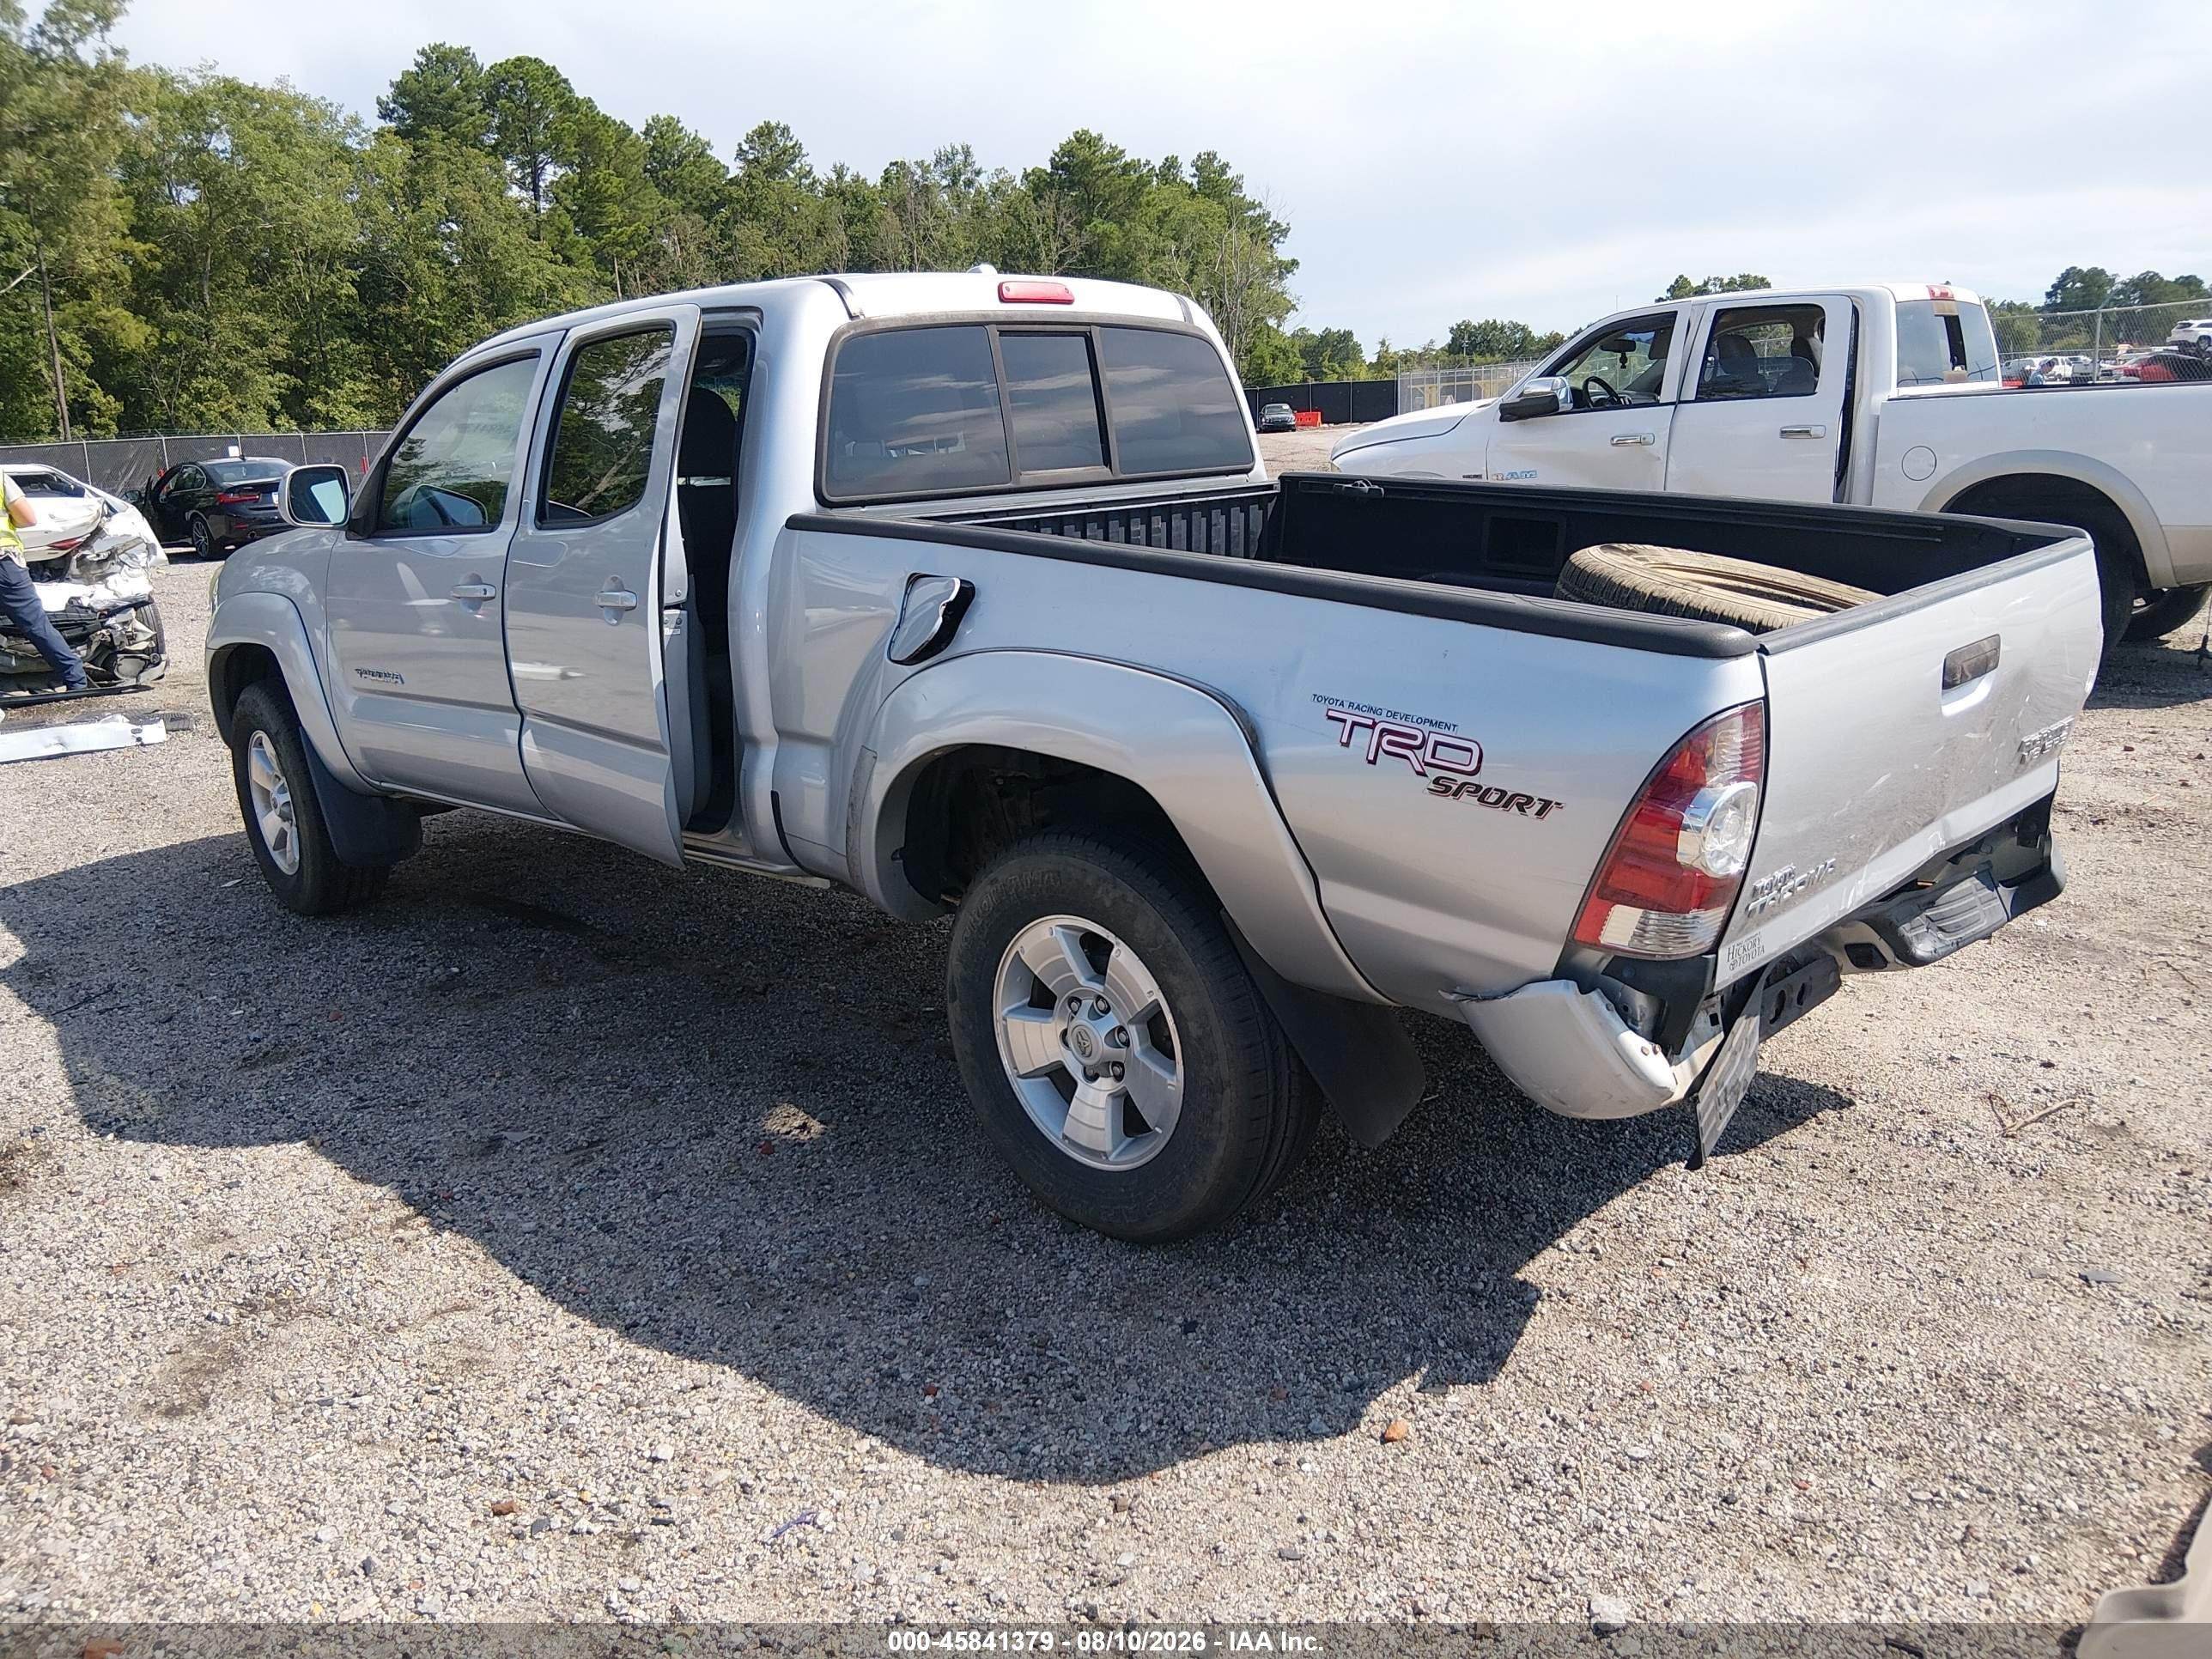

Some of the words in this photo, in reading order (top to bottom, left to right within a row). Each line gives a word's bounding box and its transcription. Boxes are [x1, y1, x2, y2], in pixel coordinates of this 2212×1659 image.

[1311, 693, 1346, 708] TOYOTA
[1347, 701, 1383, 716] RACING
[1385, 709, 1458, 732] DEVELOPMENT
[1325, 708, 1484, 777] TRD
[1425, 775, 1564, 821] SPORT
